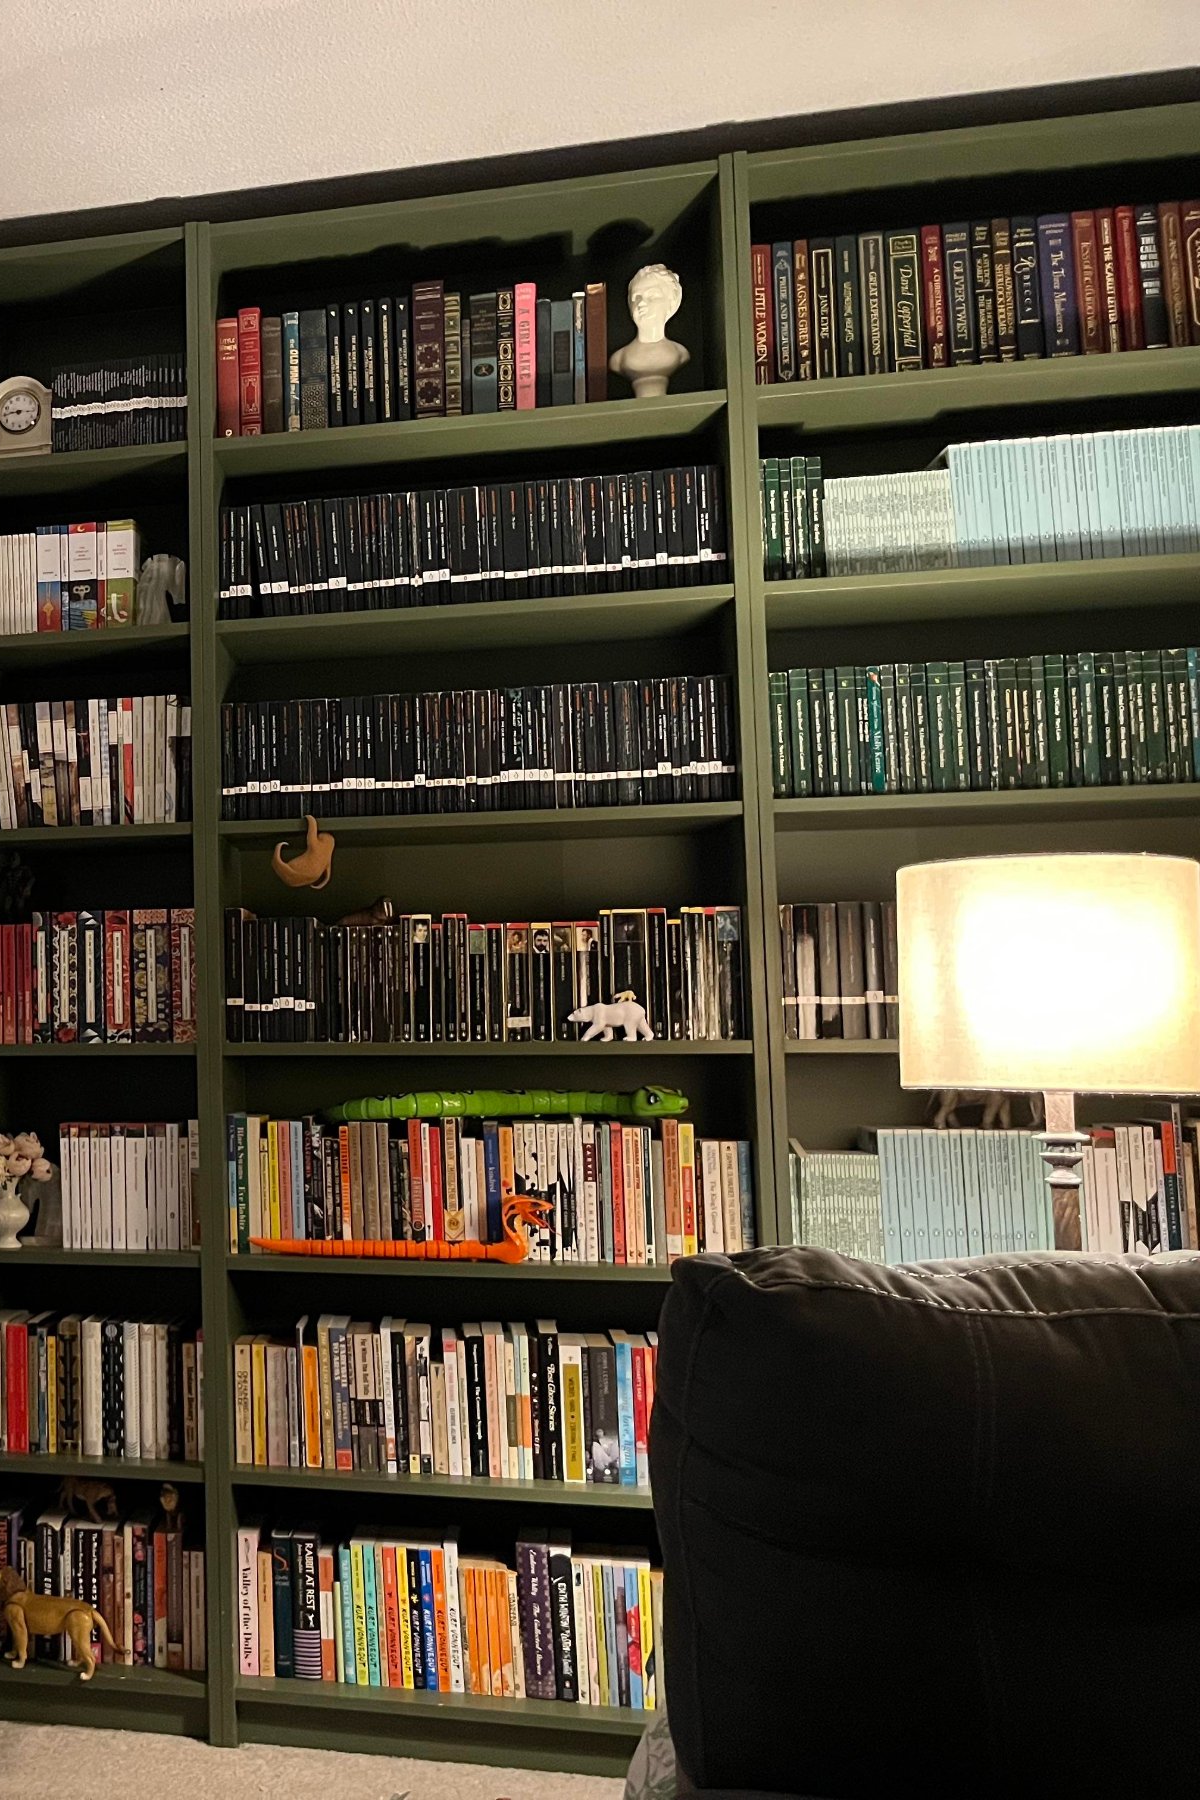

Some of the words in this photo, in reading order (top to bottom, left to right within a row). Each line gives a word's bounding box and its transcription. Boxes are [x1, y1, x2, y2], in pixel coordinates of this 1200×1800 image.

[1141, 236, 1155, 244] THE
[1051, 251, 1064, 266] The
[1104, 246, 1112, 262] THE
[869, 271, 877, 296] GREAT
[900, 265, 913, 295] David
[953, 261, 965, 301] OLIVER
[994, 264, 1004, 303] SHERLOCK
[1052, 269, 1065, 289] Three
[1105, 263, 1115, 294] SCARLET
[755, 287, 765, 319] LITTLE
[797, 284, 807, 318] AGNES
[818, 294, 828, 315] JANE
[1005, 276, 1013, 323] ADVENTURES
[1108, 296, 1117, 323] LETTER
[799, 320, 808, 346] GREY
[821, 317, 829, 338] EYRE
[870, 299, 880, 356] EXPECTATIONS
[897, 300, 916, 347] Copperfield
[956, 303, 967, 339] TWIST
[998, 305, 1006, 335] HOLMES
[520, 321, 530, 346] GIRL
[756, 321, 768, 364] WOMEN
[290, 349, 298, 364] OLD
[520, 352, 531, 379] LIKE
[290, 366, 298, 384] MAN
[547, 1364, 555, 1383] Best
[305, 1543, 314, 1573] RABBIT
[242, 1567, 252, 1596] Valley
[306, 1575, 314, 1586] AT
[243, 1599, 252, 1610] of
[306, 1589, 315, 1610] REST
[532, 1603, 540, 1617] The
[243, 1613, 252, 1630] the
[355, 1605, 364, 1624] KURT
[367, 1605, 375, 1625] KURT
[387, 1606, 395, 1627] KURT
[412, 1610, 420, 1630] KURT
[424, 1609, 432, 1630] KURT
[436, 1610, 444, 1631] KURT
[449, 1607, 457, 1628] KURT
[244, 1632, 254, 1659] Dolls
[357, 1627, 366, 1667] VONNEGUT
[369, 1628, 377, 1667] VONNEGUT
[389, 1629, 398, 1669] VONNEGUT
[413, 1633, 421, 1674] VONNEGUT
[426, 1632, 435, 1673] VONNEGUT
[439, 1633, 447, 1673] VONNEGUT
[451, 1630, 459, 1669] VONNEGUT
